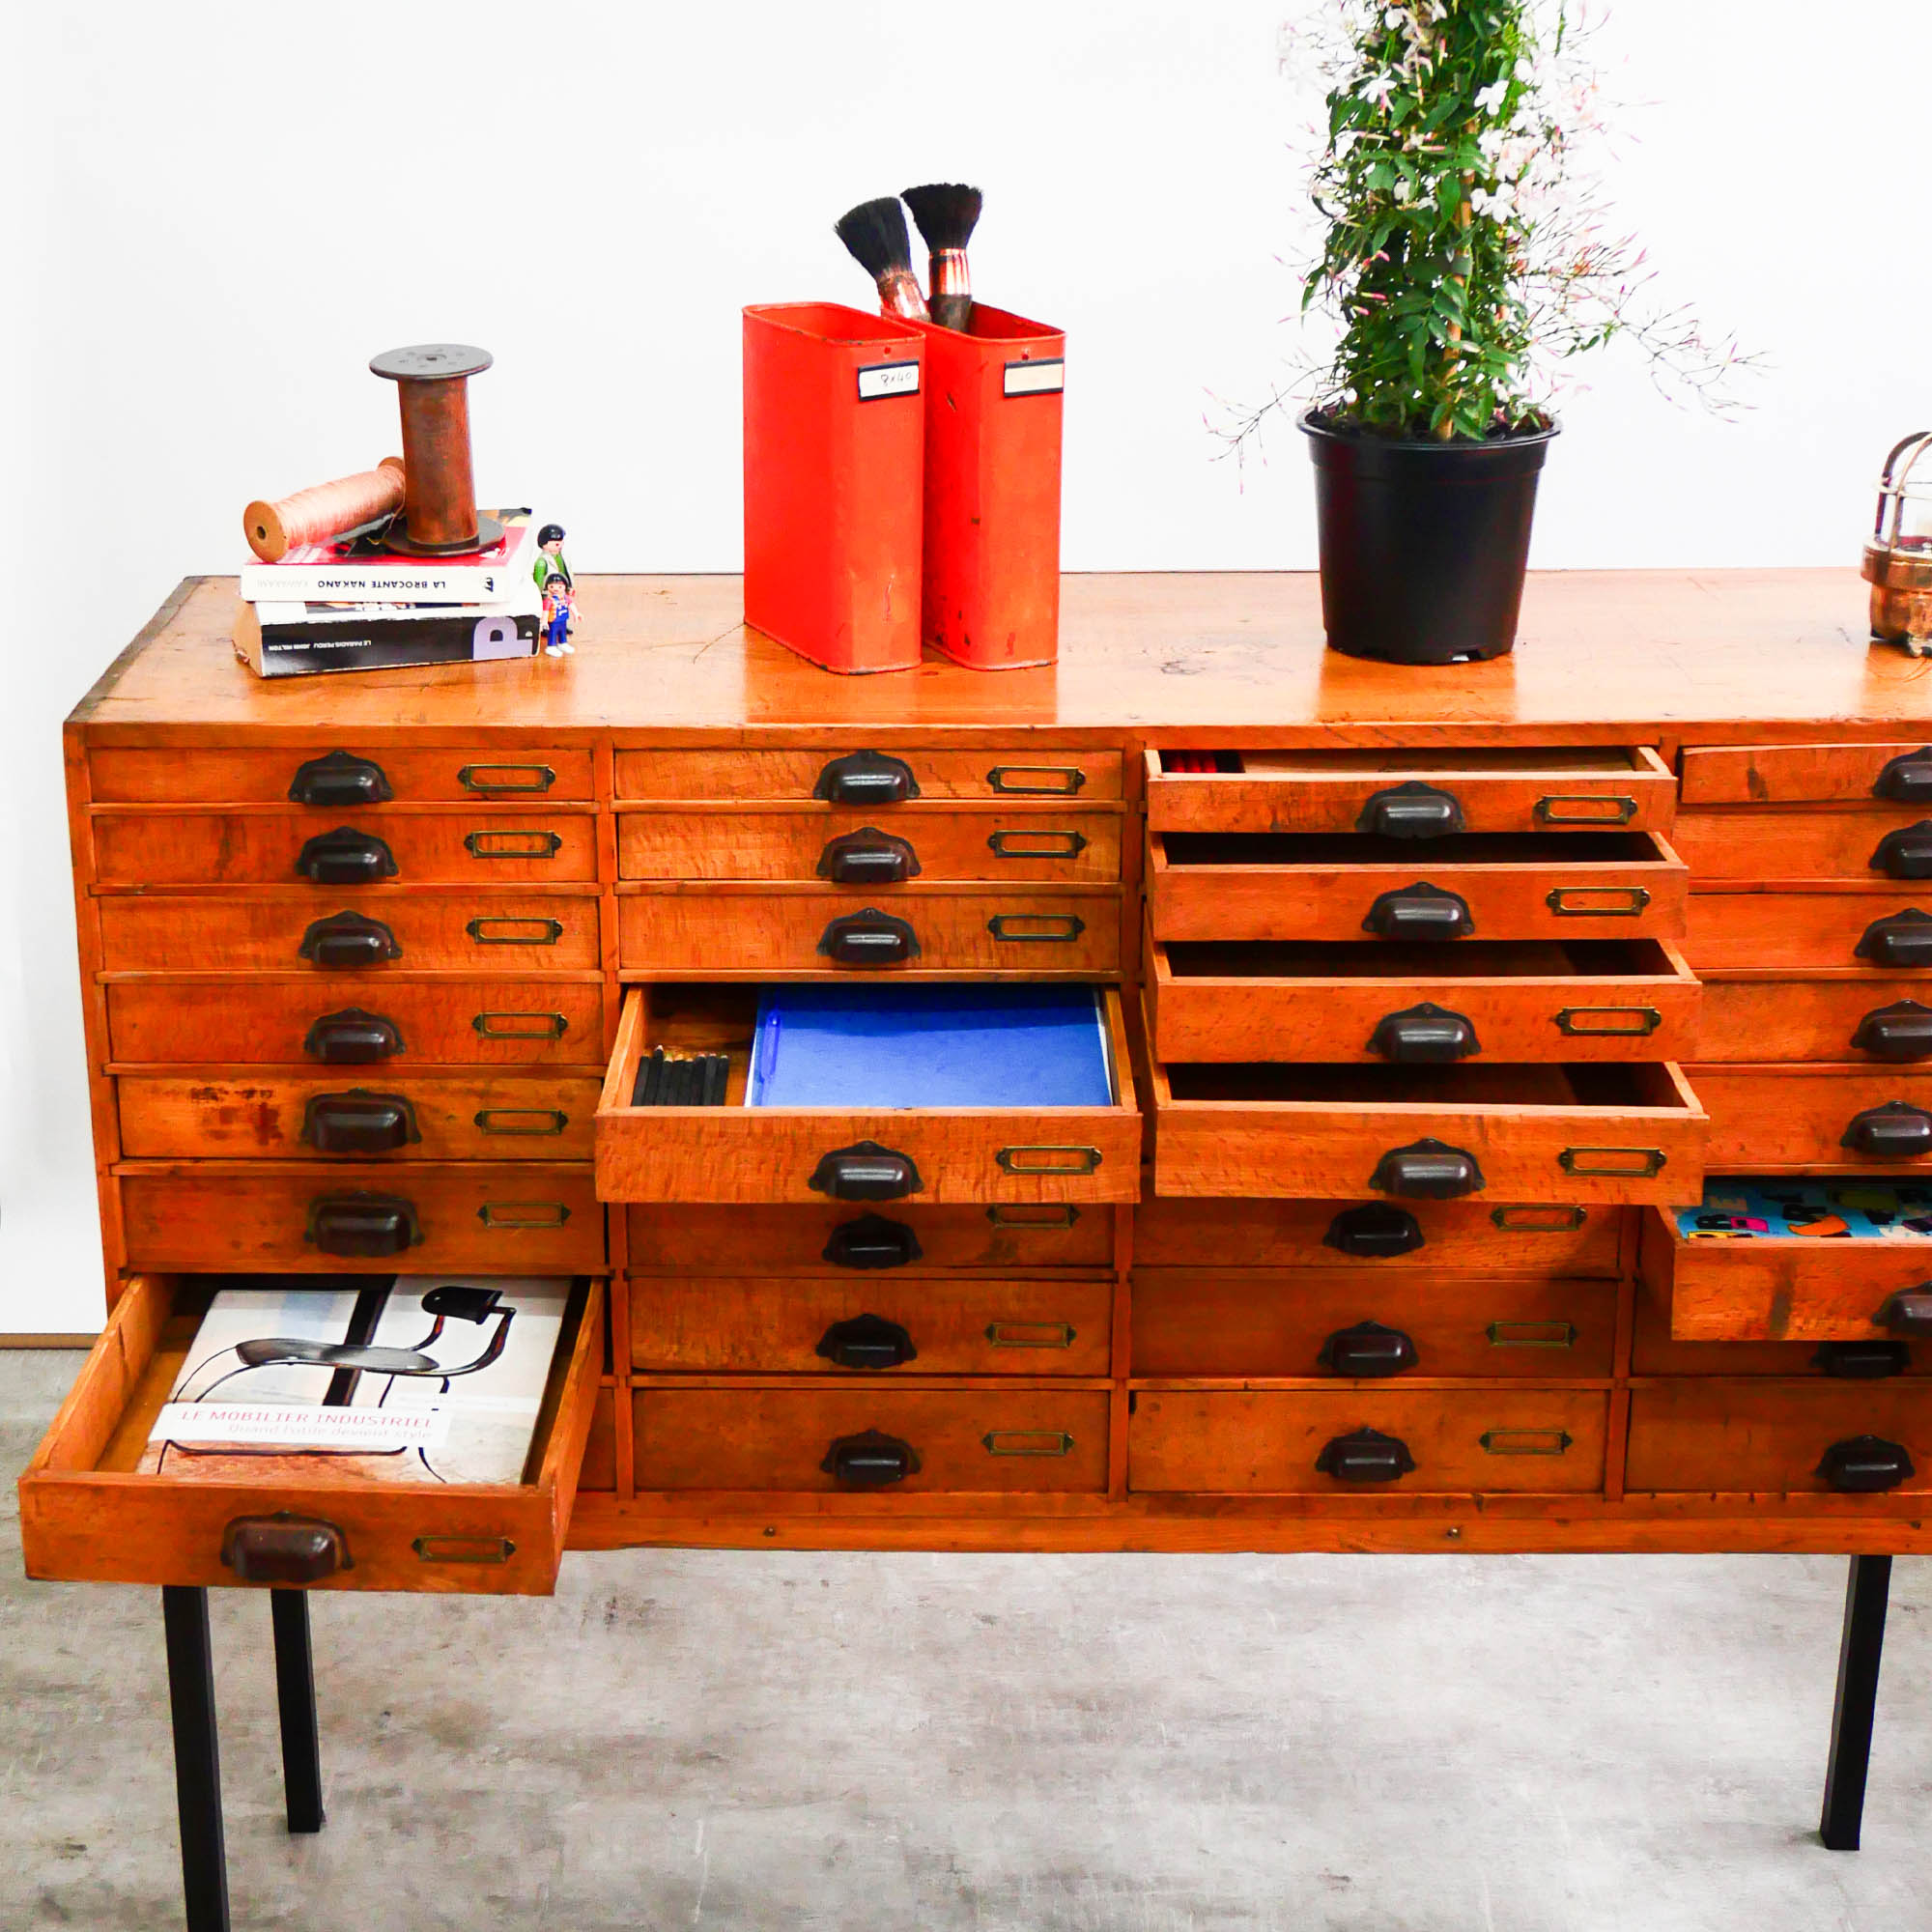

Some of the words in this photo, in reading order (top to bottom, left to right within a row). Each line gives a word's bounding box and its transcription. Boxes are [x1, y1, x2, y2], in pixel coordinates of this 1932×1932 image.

[317, 580, 366, 588] NAKANO
[371, 580, 428, 588] BROCANTE
[433, 580, 446, 588] LA
[181, 1410, 200, 1420] LE
[209, 1410, 310, 1423] MOBILIER
[317, 1413, 433, 1429] INDUSTRIEL
